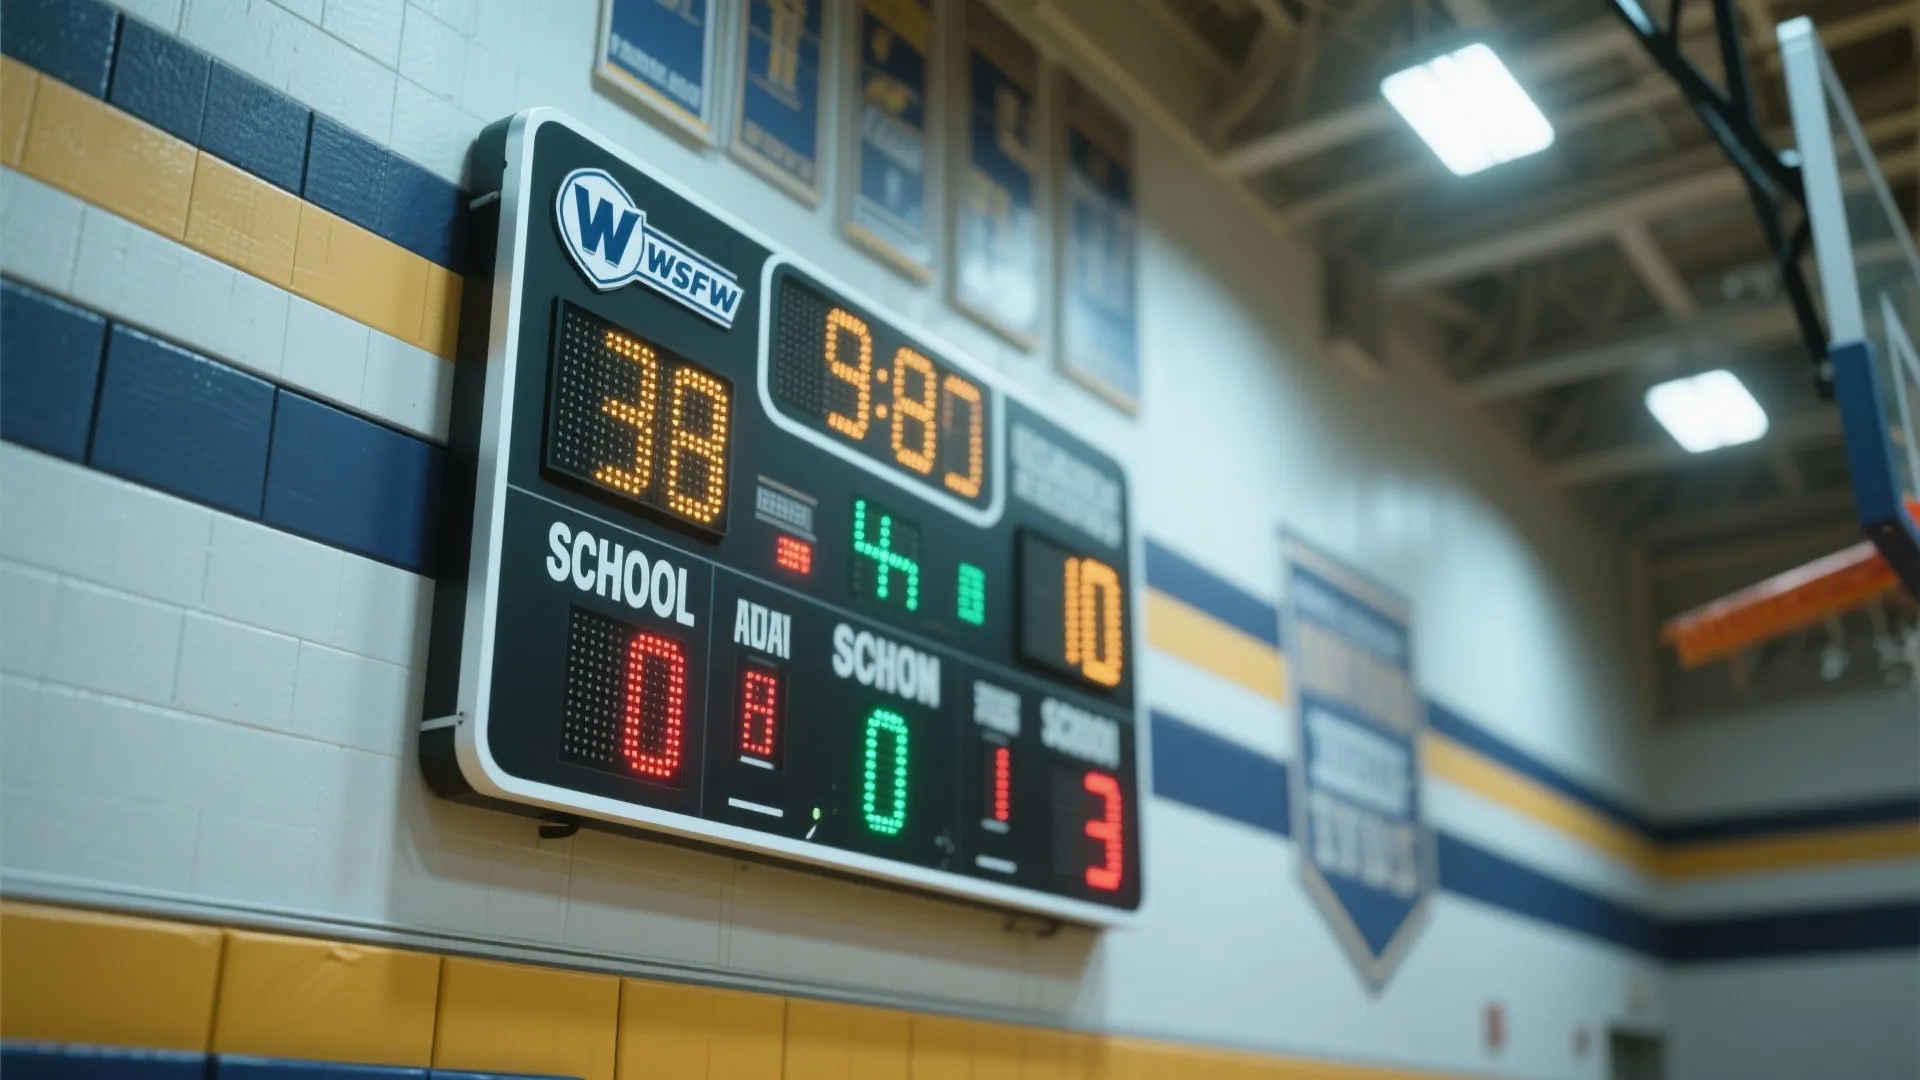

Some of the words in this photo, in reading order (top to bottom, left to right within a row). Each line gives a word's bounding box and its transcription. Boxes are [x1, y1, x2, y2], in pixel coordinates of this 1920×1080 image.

[574, 183, 641, 268] W
[648, 241, 738, 314] WSFW
[595, 331, 729, 523] 38
[546, 521, 695, 627] SCHOOL
[1064, 557, 1122, 686] 10
[623, 633, 685, 778] 0
[863, 708, 908, 835] 0
[1083, 771, 1123, 890] 3
